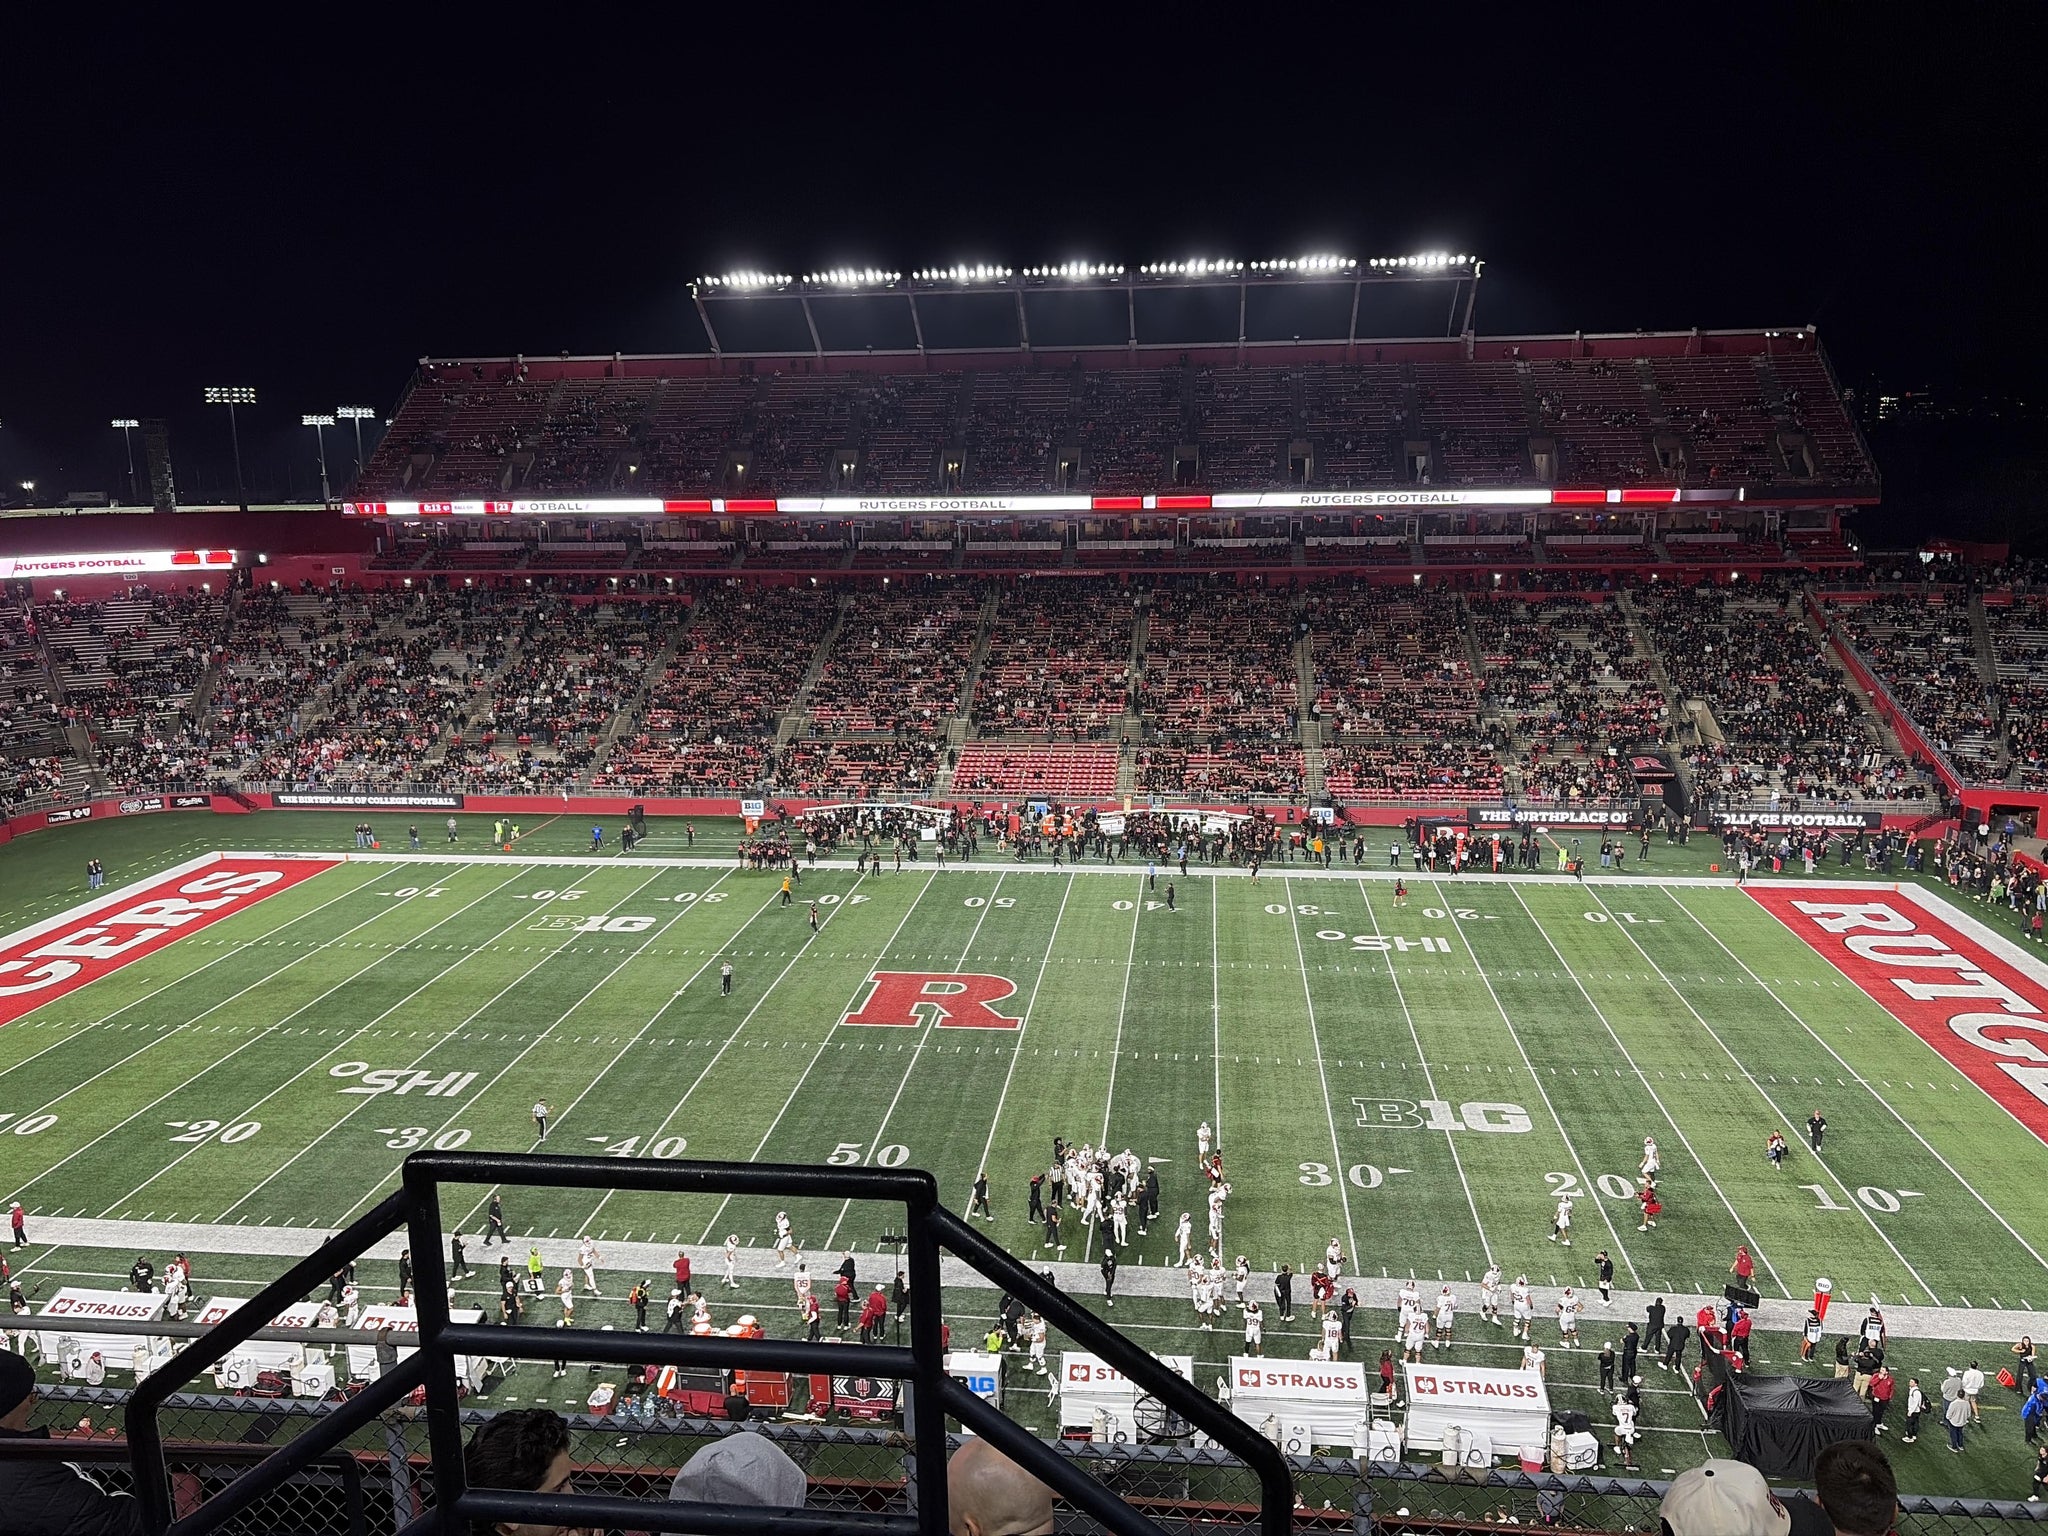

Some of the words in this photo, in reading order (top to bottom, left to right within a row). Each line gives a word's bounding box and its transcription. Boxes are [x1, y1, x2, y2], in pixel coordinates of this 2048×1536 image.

[860, 500, 927, 510] RUTGERS
[930, 499, 1006, 509] FOOTBALL
[1300, 495, 1374, 505] RUTGERS
[1377, 494, 1460, 504] FOOTBALL
[14, 561, 76, 572] RUTGERS
[78, 558, 146, 569] FOOTBALL
[279, 795, 298, 803] THE
[299, 796, 354, 804] BIRTHPLACE
[367, 797, 408, 805] COLLEGE
[409, 797, 457, 805] FOOTBALL
[1480, 811, 1511, 821] THE
[1716, 813, 1780, 826] OLLEGE
[1782, 814, 1867, 827] FOOTBALL
[394, 887, 451, 897] 10
[531, 890, 589, 900] 20
[673, 892, 729, 903] 30
[818, 894, 871, 905] 40
[963, 897, 1017, 908] 50
[1112, 900, 1166, 911] 40
[1264, 904, 1319, 915] 30
[1422, 908, 1480, 920] 20
[1583, 911, 1645, 923] 10
[841, 972, 1023, 1030] R
[168, 1120, 262, 1143] 20
[386, 1127, 472, 1151] 30
[604, 1136, 687, 1159] 40
[826, 1143, 910, 1167] 50
[1298, 1162, 1383, 1188] 30
[1544, 1172, 1636, 1199] 20
[1797, 1184, 1901, 1212] 10
[797, 1280, 808, 1288] 35
[1403, 1298, 1415, 1307] 70
[73, 1302, 152, 1317] STRAUSS
[1247, 1318, 1259, 1326] 39
[1412, 1321, 1425, 1331] 76
[1327, 1329, 1338, 1338] 18
[1266, 1373, 1358, 1389] STRAUSS
[1442, 1380, 1538, 1398] STRAUSS
[1621, 1412, 1629, 1423] 7
